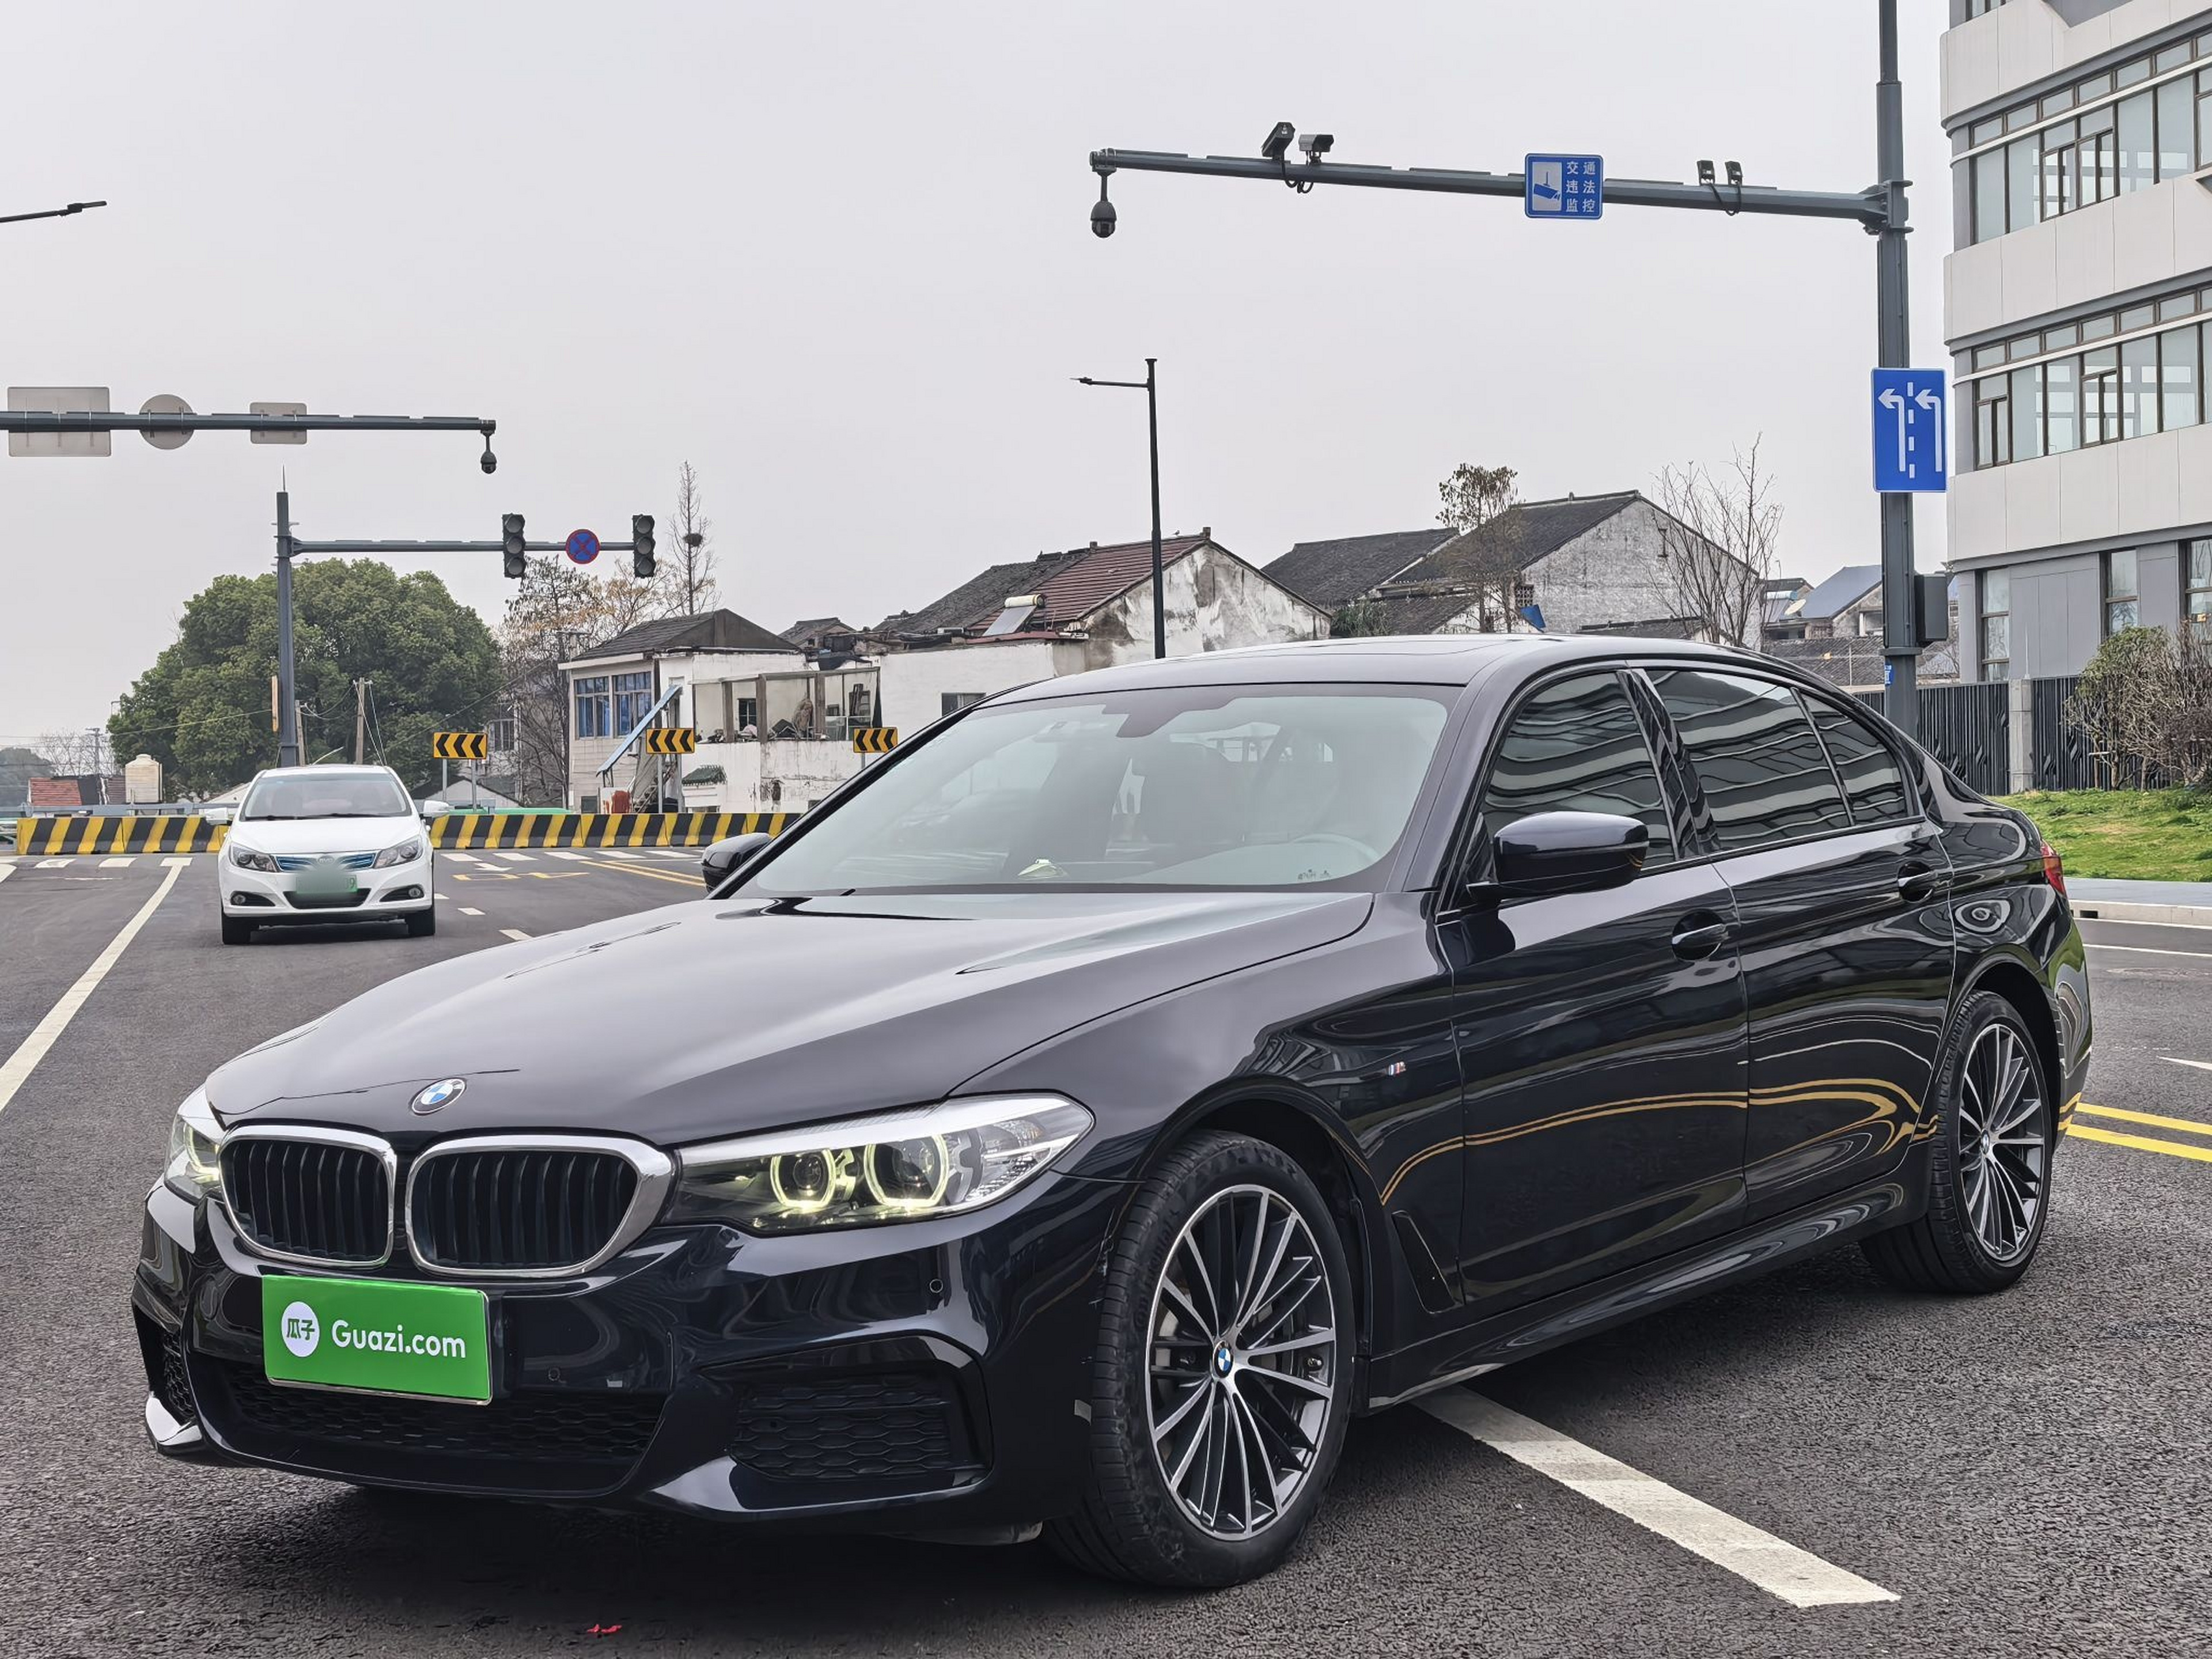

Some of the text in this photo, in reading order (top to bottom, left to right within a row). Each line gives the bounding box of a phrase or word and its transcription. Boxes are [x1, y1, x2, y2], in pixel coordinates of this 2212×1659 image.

[1566, 161, 1596, 175] 交通
[1566, 180, 1596, 194] 违法
[1566, 198, 1596, 212] 监控
[286, 1318, 466, 1358] 瓜子 Guazi.com
